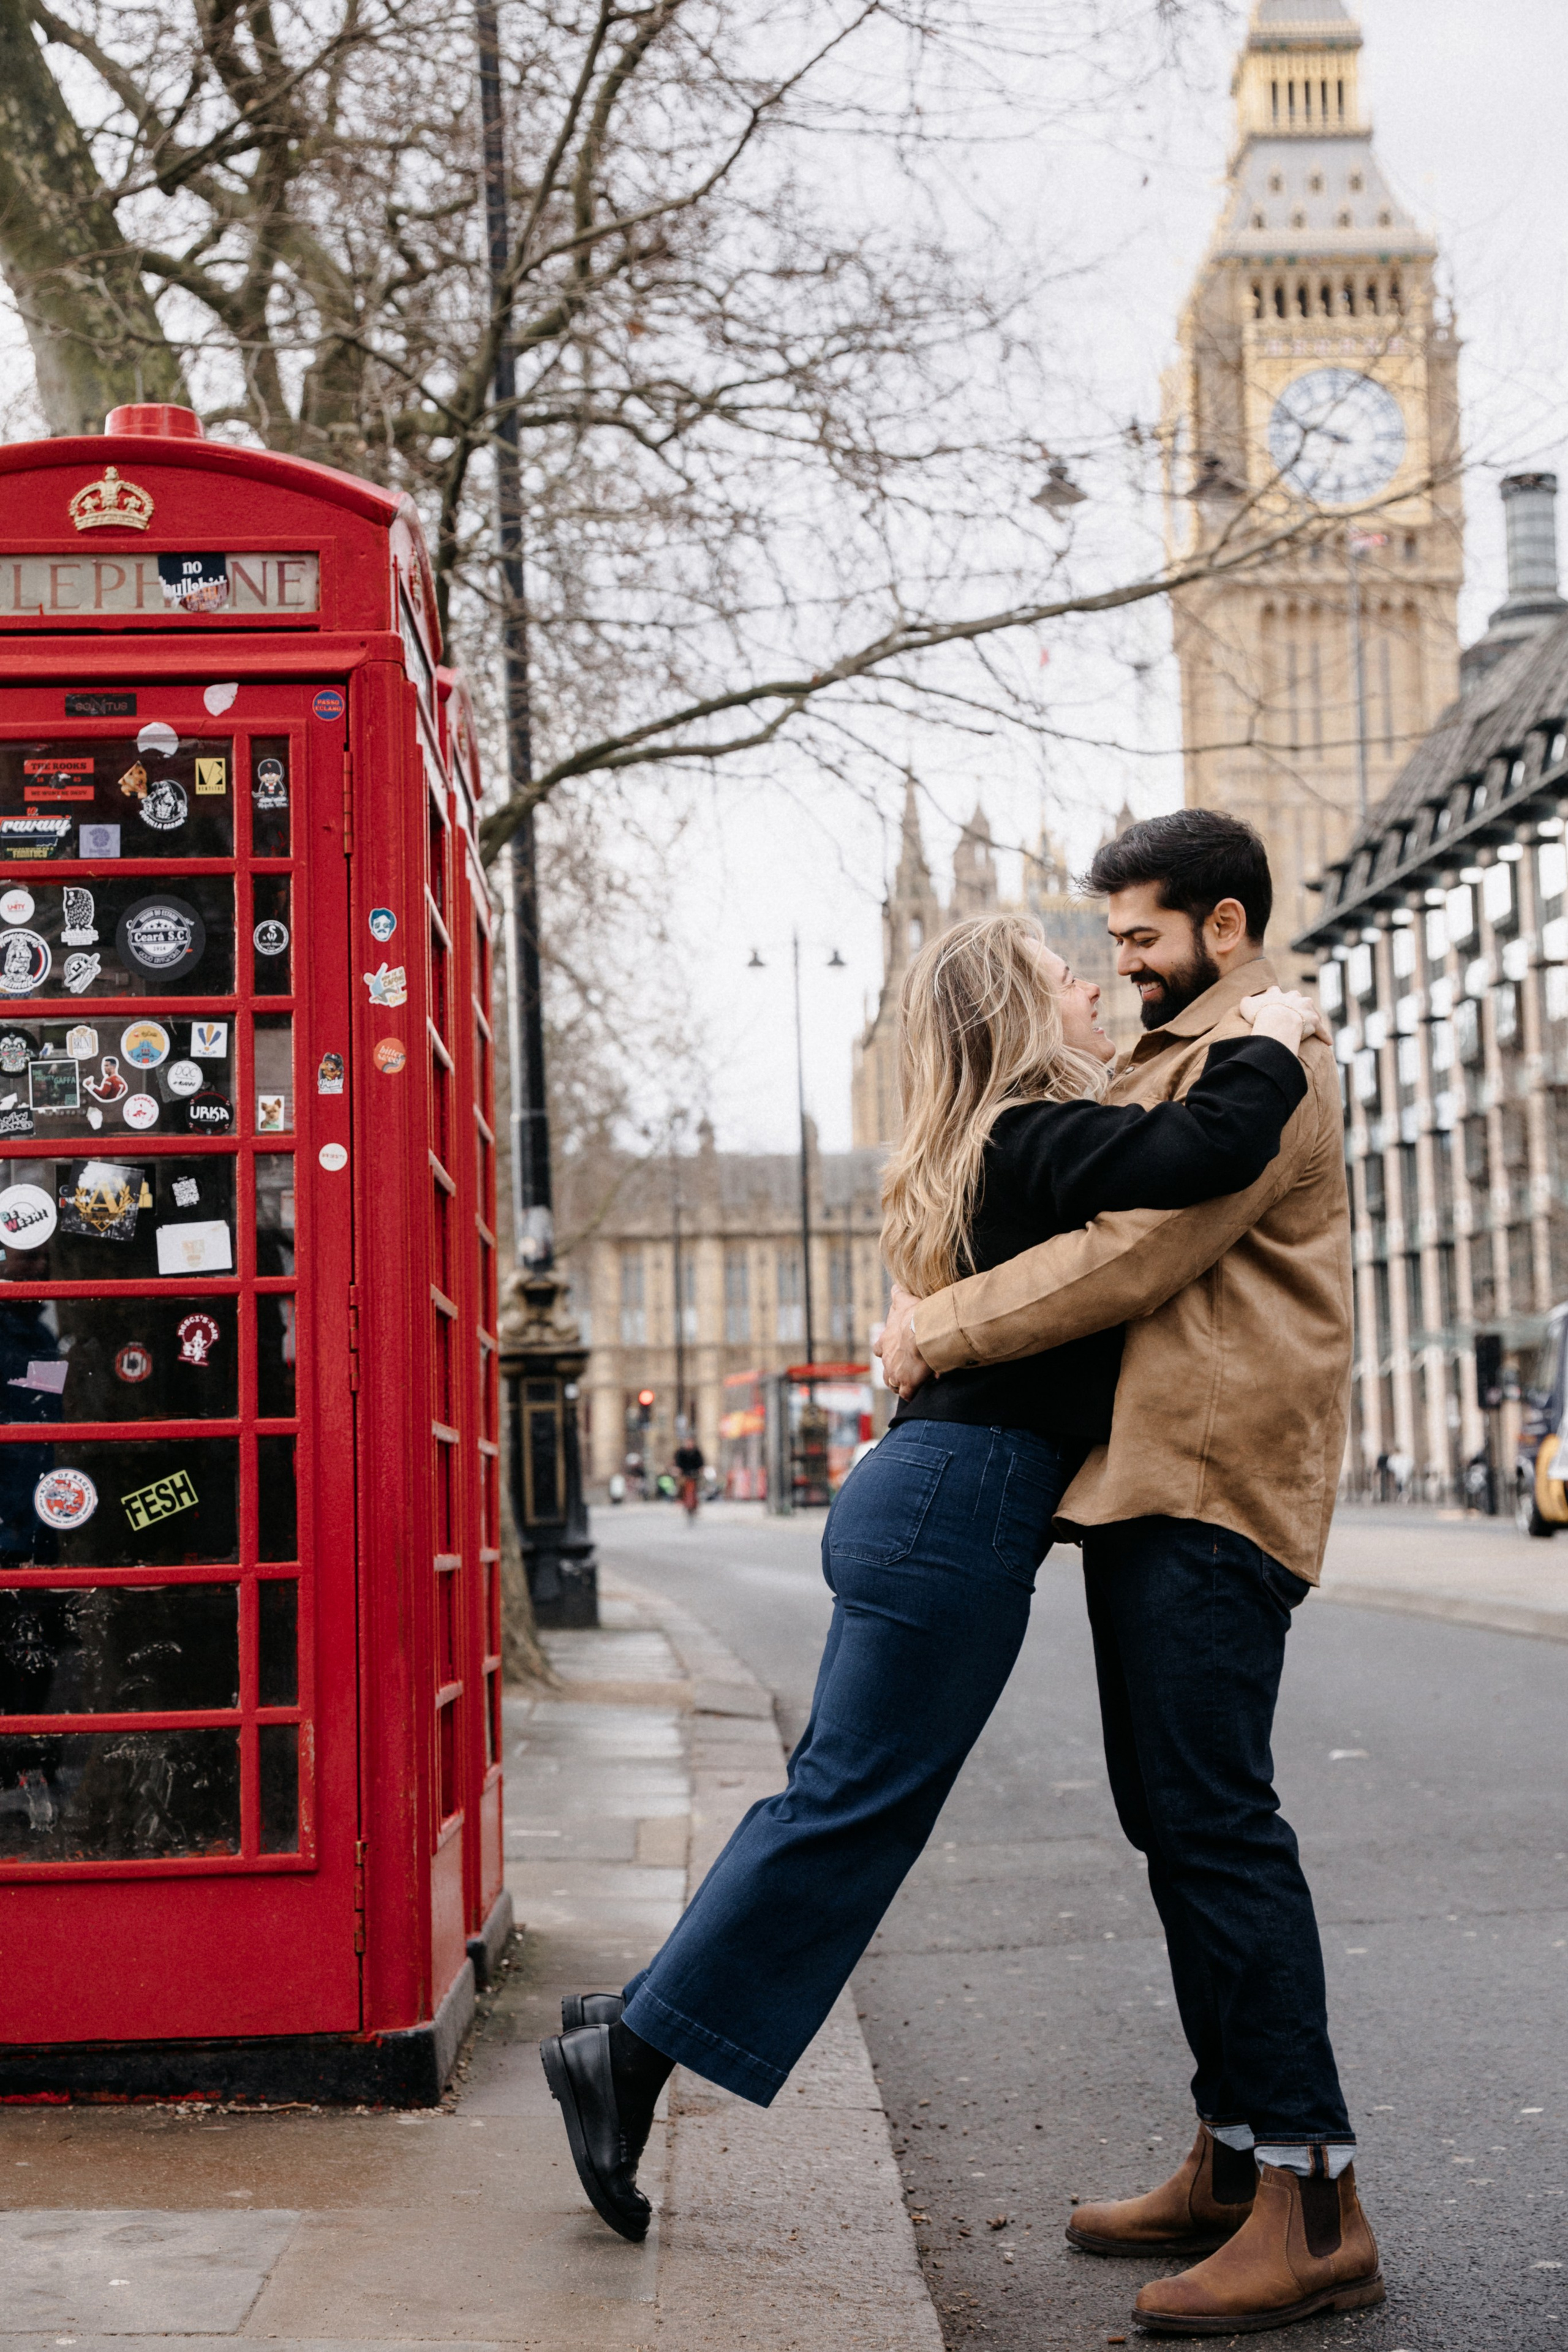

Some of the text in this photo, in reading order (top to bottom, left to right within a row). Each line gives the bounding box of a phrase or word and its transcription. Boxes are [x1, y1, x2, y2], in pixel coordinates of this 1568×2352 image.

[182, 560, 202, 575] no
[0, 556, 306, 609] LEPHNE
[134, 930, 184, 943] Ceará S.C
[53, 1076, 77, 1085] GAFFA
[189, 1106, 230, 1122] URKA
[73, 1474, 90, 1491] RAGE
[124, 1473, 197, 1528] FESH
